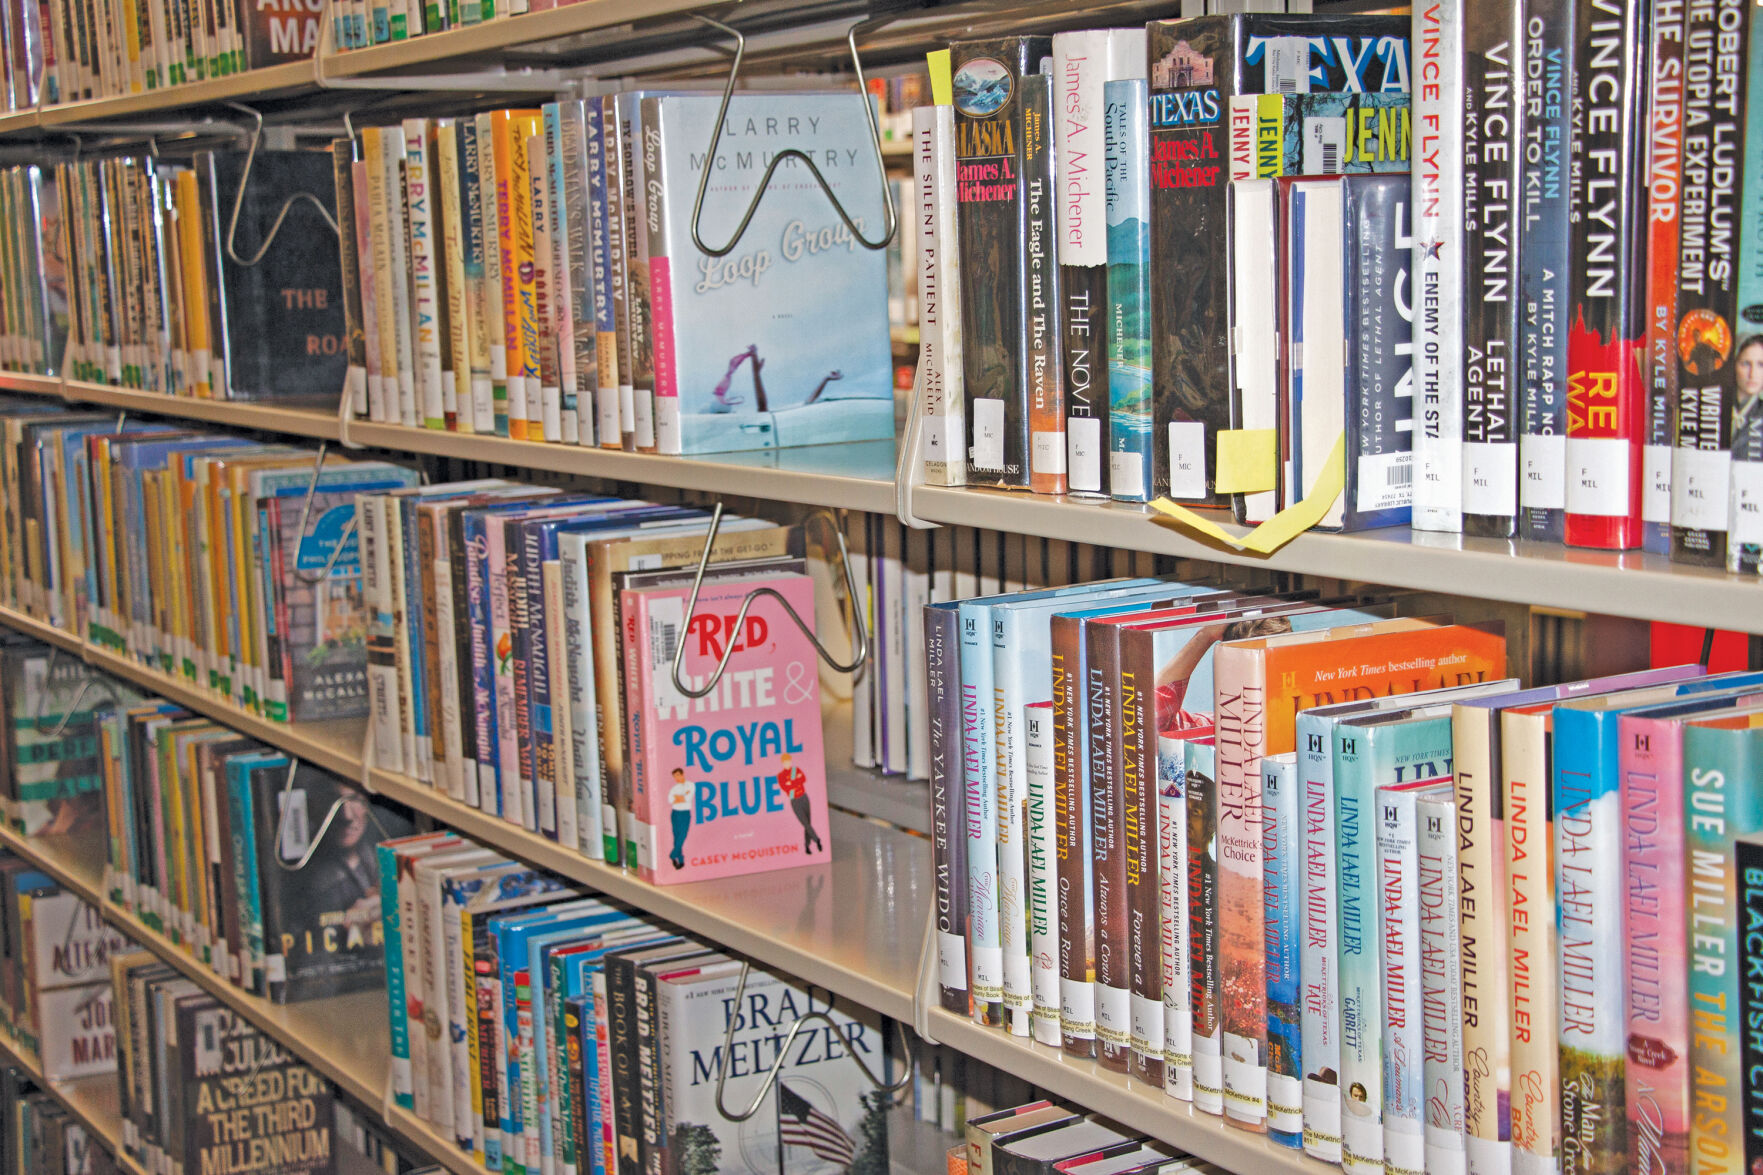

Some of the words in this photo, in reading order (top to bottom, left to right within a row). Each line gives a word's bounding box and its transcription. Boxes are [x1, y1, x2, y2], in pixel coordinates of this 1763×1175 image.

[269, 16, 321, 54] MA
[1422, 3, 1440, 102] VINCE
[1065, 53, 1088, 115] James
[1527, 17, 1544, 117] ORDER
[1545, 48, 1562, 119] VINCE
[1686, 30, 1714, 128] UTOPIA
[726, 117, 820, 136] LARRY
[1106, 102, 1118, 148] South
[1119, 102, 1127, 136] TALES
[1149, 89, 1221, 126] TEXAS
[1483, 41, 1509, 163] VINCE
[1571, 98, 1583, 153] KYLE
[464, 119, 477, 177] LARRY
[587, 111, 600, 188] LARRY
[644, 125, 660, 174] Loop
[690, 149, 858, 171] McMURTRY
[921, 128, 931, 162] THE
[1066, 120, 1089, 144] A.
[1120, 138, 1127, 153] OF
[1152, 135, 1198, 162] James
[1200, 132, 1219, 159] A.
[1233, 107, 1250, 165] JENNY
[1465, 112, 1477, 165] KYLE
[1527, 126, 1542, 164] TO
[1651, 56, 1681, 224] SURVIVOR
[407, 134, 425, 214] TERRY
[624, 142, 636, 211] SORROW'S
[1106, 152, 1120, 212] Pacific
[1120, 156, 1128, 182] THE
[1151, 162, 1220, 189] Michener
[1422, 114, 1440, 218] FLYNN
[1544, 126, 1561, 199] FLYNN
[498, 180, 510, 240] TERRY
[533, 176, 544, 234] LARRY
[649, 178, 663, 234] Group
[923, 173, 934, 238] SILENT
[1030, 178, 1042, 215] The
[1067, 150, 1086, 249] Michener
[1465, 172, 1477, 231] MILLS
[1525, 171, 1541, 232] KILL
[1570, 162, 1581, 224] MILLS
[1681, 134, 1710, 295] EXPERIMENT
[1708, 122, 1737, 280] LUDLUM'S
[627, 217, 637, 259] RIVER
[1029, 220, 1044, 268] Eagle
[1483, 179, 1508, 302] FLYNN
[1586, 149, 1617, 297] FLYNN
[412, 221, 432, 344] McMILLAN
[592, 200, 606, 322] McMURTRY
[695, 250, 772, 294] Loop
[782, 216, 866, 262] Group
[1373, 244, 1383, 297] AGENT
[281, 289, 328, 310] THE
[924, 247, 938, 326] PATIENT
[1032, 274, 1044, 309] and
[1070, 290, 1089, 338] THE
[1423, 271, 1440, 336] ENEMY
[1032, 311, 1046, 350] The
[1115, 302, 1124, 369] MICHENER
[1373, 306, 1383, 365] LETHAL
[1542, 289, 1555, 349] MITCH
[1034, 355, 1045, 409] Raven
[1360, 333, 1371, 380] TIMES
[1423, 341, 1440, 366] OF
[1527, 329, 1537, 381] KYLE
[1542, 356, 1554, 405] RAPP
[1655, 337, 1666, 392] KYLE
[934, 371, 942, 403] ALEX
[1360, 386, 1371, 427] YORK
[1373, 372, 1383, 394] OF
[1423, 370, 1440, 405] THE
[1467, 347, 1483, 441] AGENT
[1486, 340, 1505, 444] LETHAL
[525, 532, 539, 597] JUDITH
[515, 576, 529, 630] JUDITH
[688, 614, 776, 664] RED,
[935, 625, 943, 666] LINDA
[1314, 671, 1336, 683] New
[1337, 666, 1357, 679] York
[1360, 664, 1386, 676] Times
[1388, 656, 1436, 672] bestselling
[1438, 653, 1467, 666] author
[513, 658, 530, 739] REMEMBER
[654, 667, 776, 720] WHITE
[783, 660, 814, 705] &
[1053, 654, 1064, 716] LINDA
[672, 719, 803, 773] ROYAL
[932, 717, 942, 749] The
[1053, 724, 1066, 773] LAEL
[1242, 686, 1263, 766] LINDA
[520, 742, 533, 781] WHEN
[1220, 689, 1243, 822] MILLER
[695, 775, 784, 825] BLUE
[933, 752, 947, 850] YANKEE
[1055, 782, 1068, 860] MILLER
[1243, 772, 1263, 831] LAEL
[1306, 780, 1326, 835] LINDA
[1340, 796, 1359, 848] LINDA
[1459, 771, 1474, 852] LINDA
[1510, 781, 1527, 862] LINDA
[1561, 769, 1593, 857] LINDA
[1692, 768, 1725, 835] SUE
[691, 855, 728, 867] CASEY
[731, 844, 799, 862] McQUISTON
[1221, 835, 1263, 850] McKettrick's
[1223, 847, 1256, 863] Choice
[1307, 840, 1325, 885] LAEL
[1060, 877, 1070, 914] Once
[1099, 872, 1112, 926] Always
[1342, 852, 1359, 893] LAEL
[1419, 854, 1443, 924] LINDA
[1461, 861, 1476, 925] LAEL
[1562, 864, 1593, 928] LAEL
[1205, 908, 1213, 926] York
[1308, 883, 1327, 949] MILLER
[1343, 895, 1361, 955] MILLER
[1512, 874, 1528, 937] LAEL
[1692, 850, 1726, 977] MILLER
[1132, 909, 1143, 970] Forever
[1205, 929, 1213, 952] Times
[1421, 928, 1445, 979] LAEL
[1206, 954, 1214, 998] Bestselling
[1308, 983, 1321, 1017] TATE
[1462, 934, 1478, 1029] MILLER
[1513, 948, 1530, 1044] MILLER
[1563, 934, 1594, 1036] MILLER
[614, 991, 628, 1048] BOOK
[635, 976, 650, 1037] BRAD
[722, 985, 836, 1034] BRAD
[1344, 997, 1357, 1049] GARRETT
[1423, 982, 1448, 1065] MILLER
[1694, 992, 1727, 1055] THE
[618, 1053, 629, 1078] OF
[690, 1021, 872, 1087] MELTZER
[208, 1109, 251, 1143] THE
[253, 1098, 316, 1135] THIRD
[640, 1044, 657, 1145] MELTZER
[200, 1127, 329, 1175] MILLENNIUM
